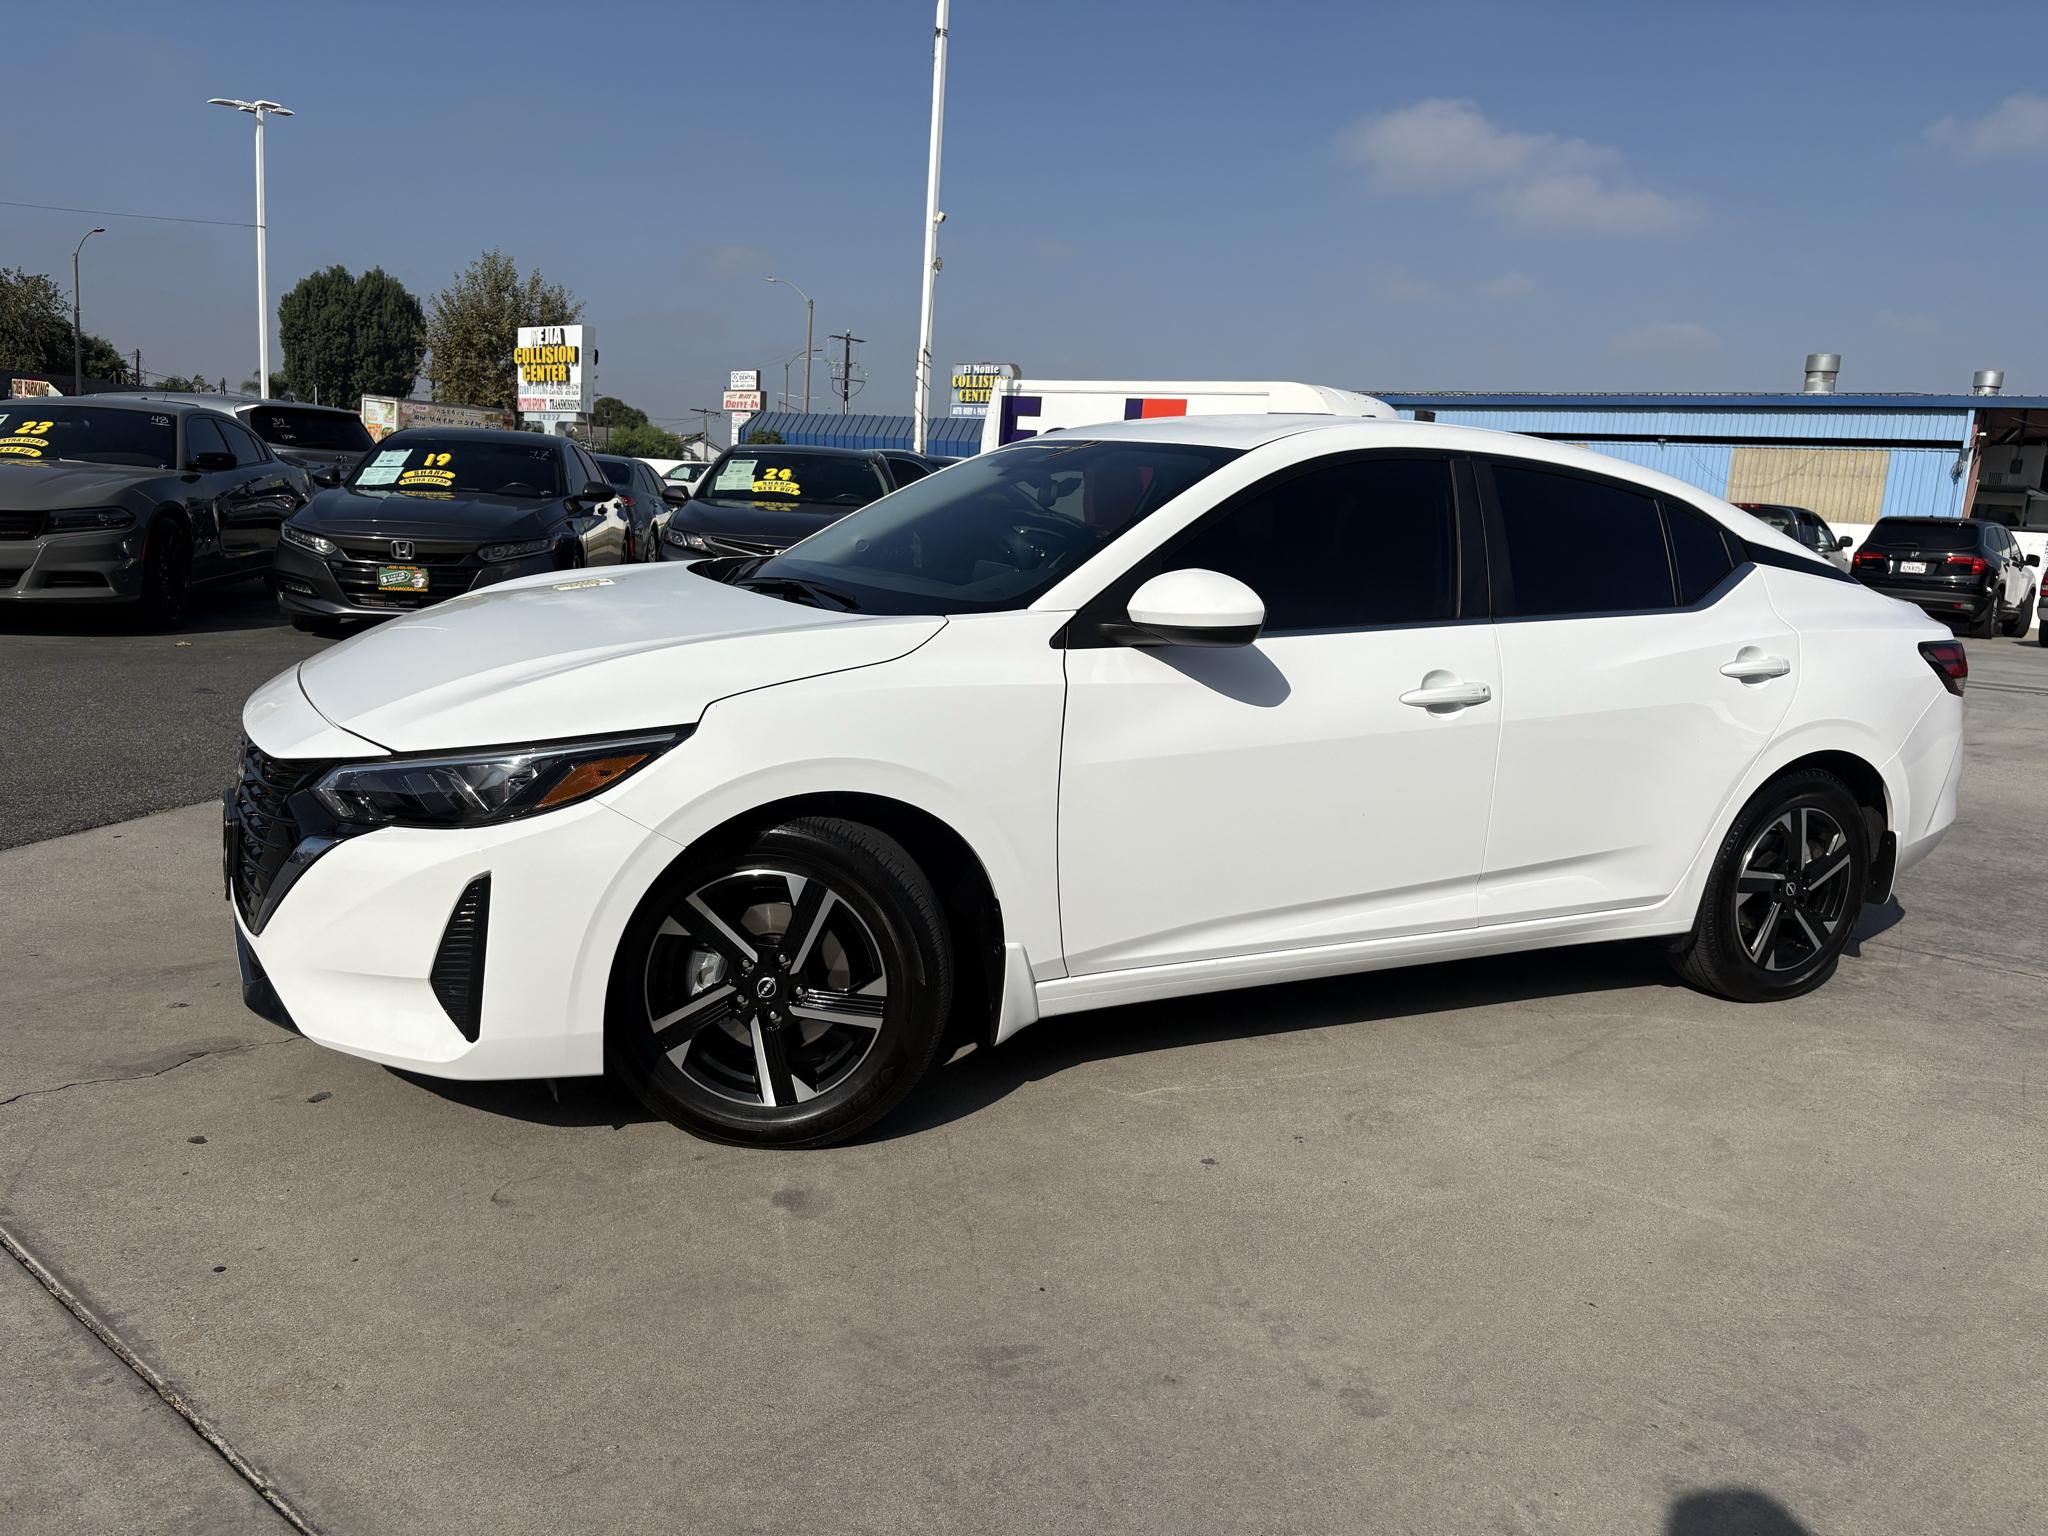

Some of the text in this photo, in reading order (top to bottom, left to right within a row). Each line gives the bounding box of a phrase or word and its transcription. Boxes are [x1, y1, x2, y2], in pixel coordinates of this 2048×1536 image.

[513, 346, 576, 364] COLLISION
[522, 364, 567, 382] CENTER
[963, 365, 1000, 374] El Monte
[952, 375, 1008, 389] COLLISI
[25, 382, 49, 397] PARKING
[959, 389, 991, 403] CENTE
[549, 399, 581, 410] TRANSMISSION
[14, 421, 54, 434] 23
[424, 453, 452, 467] 19
[763, 467, 792, 480] 24
[427, 477, 449, 485] CLEAN
[780, 486, 794, 494] BUY
